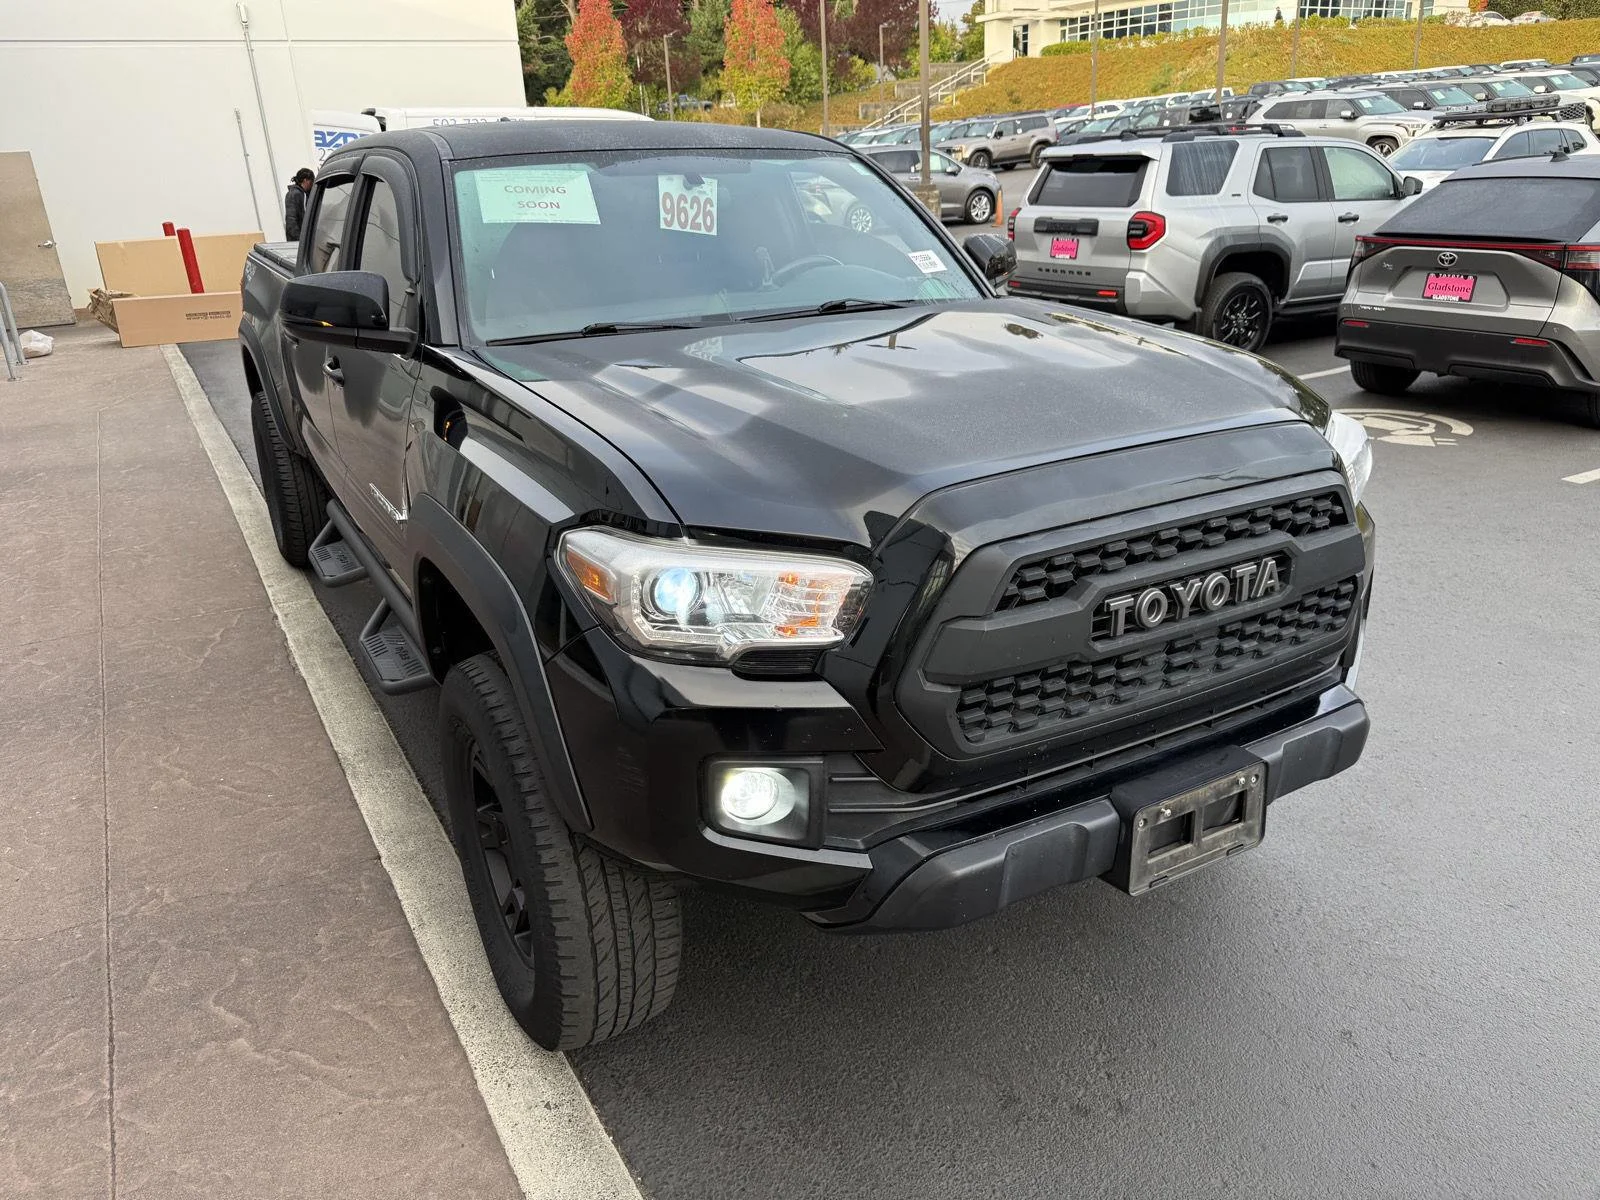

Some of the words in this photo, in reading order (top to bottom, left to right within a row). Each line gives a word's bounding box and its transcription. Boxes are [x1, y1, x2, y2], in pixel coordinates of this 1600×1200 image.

[504, 185, 567, 194] COMING
[518, 201, 561, 209] SOON
[661, 191, 715, 233] 9626
[1427, 281, 1472, 293] Gladstone
[1104, 557, 1281, 637] TOYOTA
